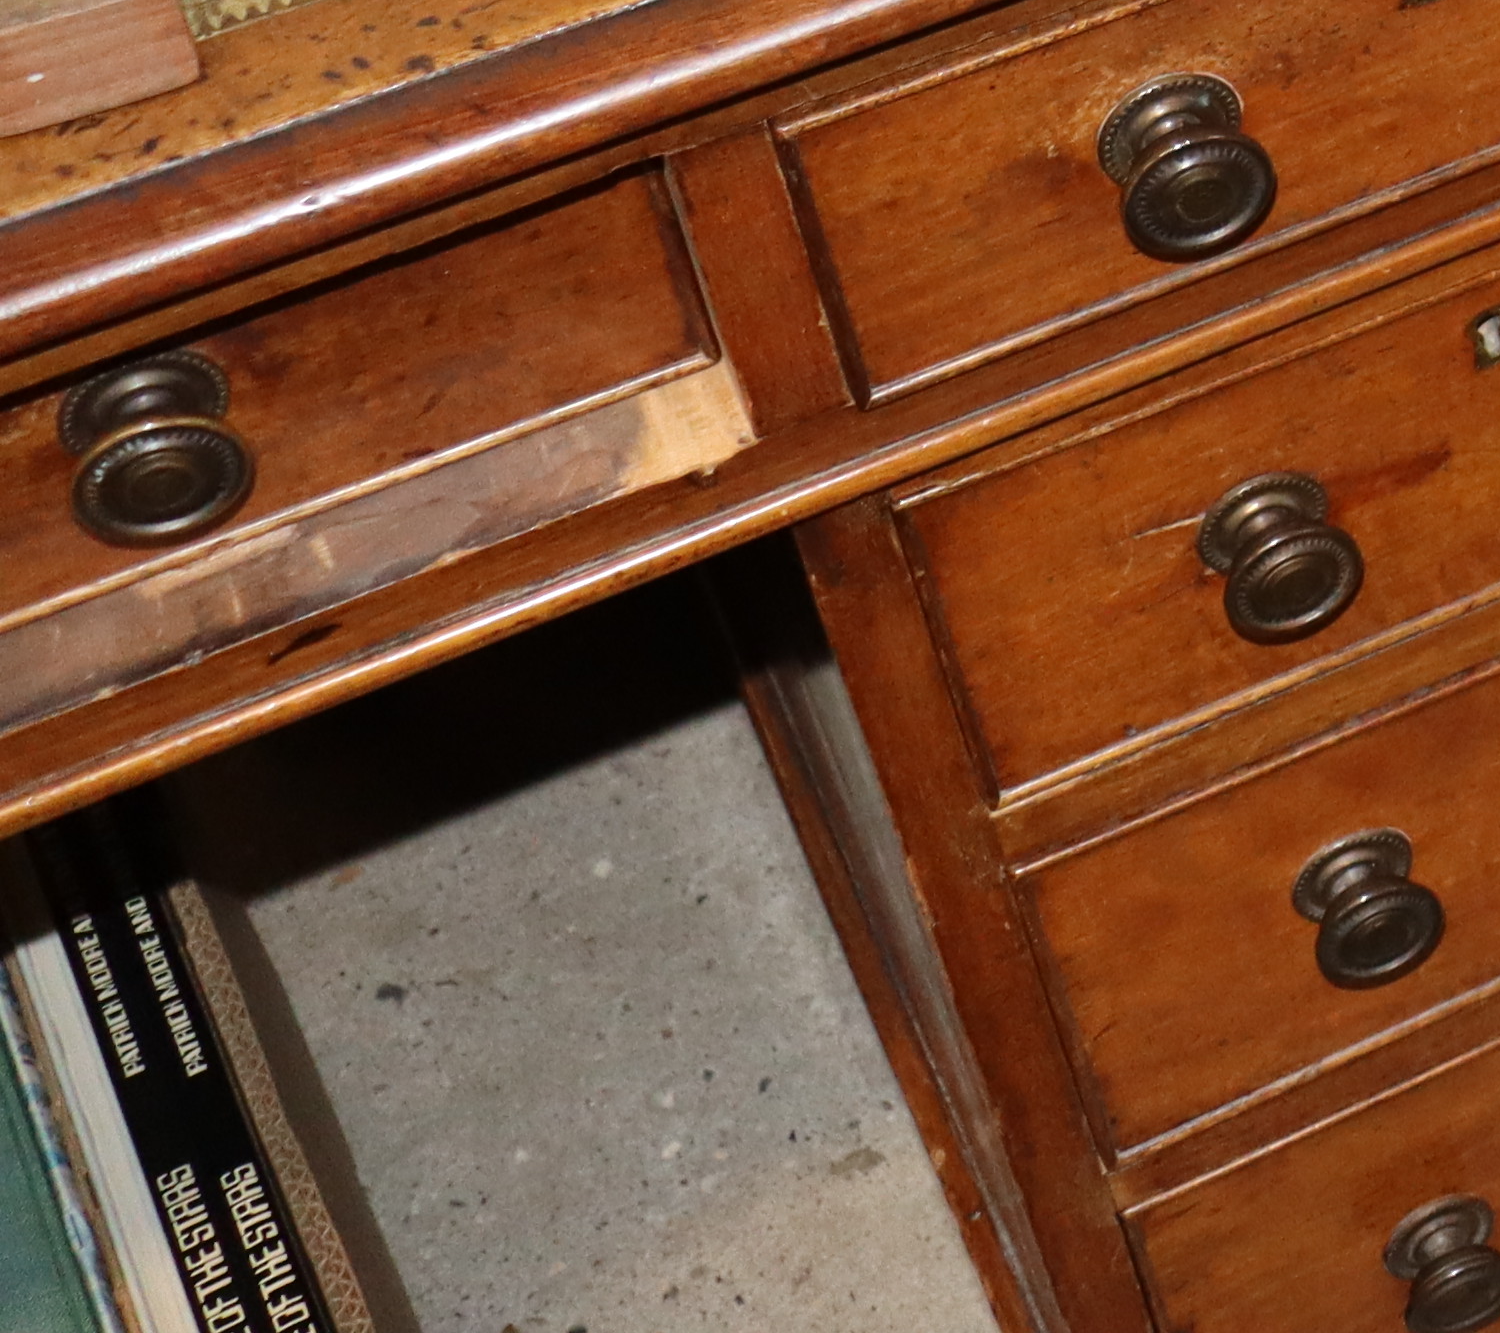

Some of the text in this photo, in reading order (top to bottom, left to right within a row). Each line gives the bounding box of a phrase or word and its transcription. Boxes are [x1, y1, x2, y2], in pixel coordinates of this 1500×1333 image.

[76, 936, 120, 1004] MOORE
[123, 894, 209, 1079] PATRICK MOORE AND
[102, 1000, 147, 1079] PATRICK
[155, 1162, 217, 1253] STARS
[218, 1161, 280, 1252] STARS
[184, 1239, 235, 1311] THE
[248, 1239, 299, 1310] THE
